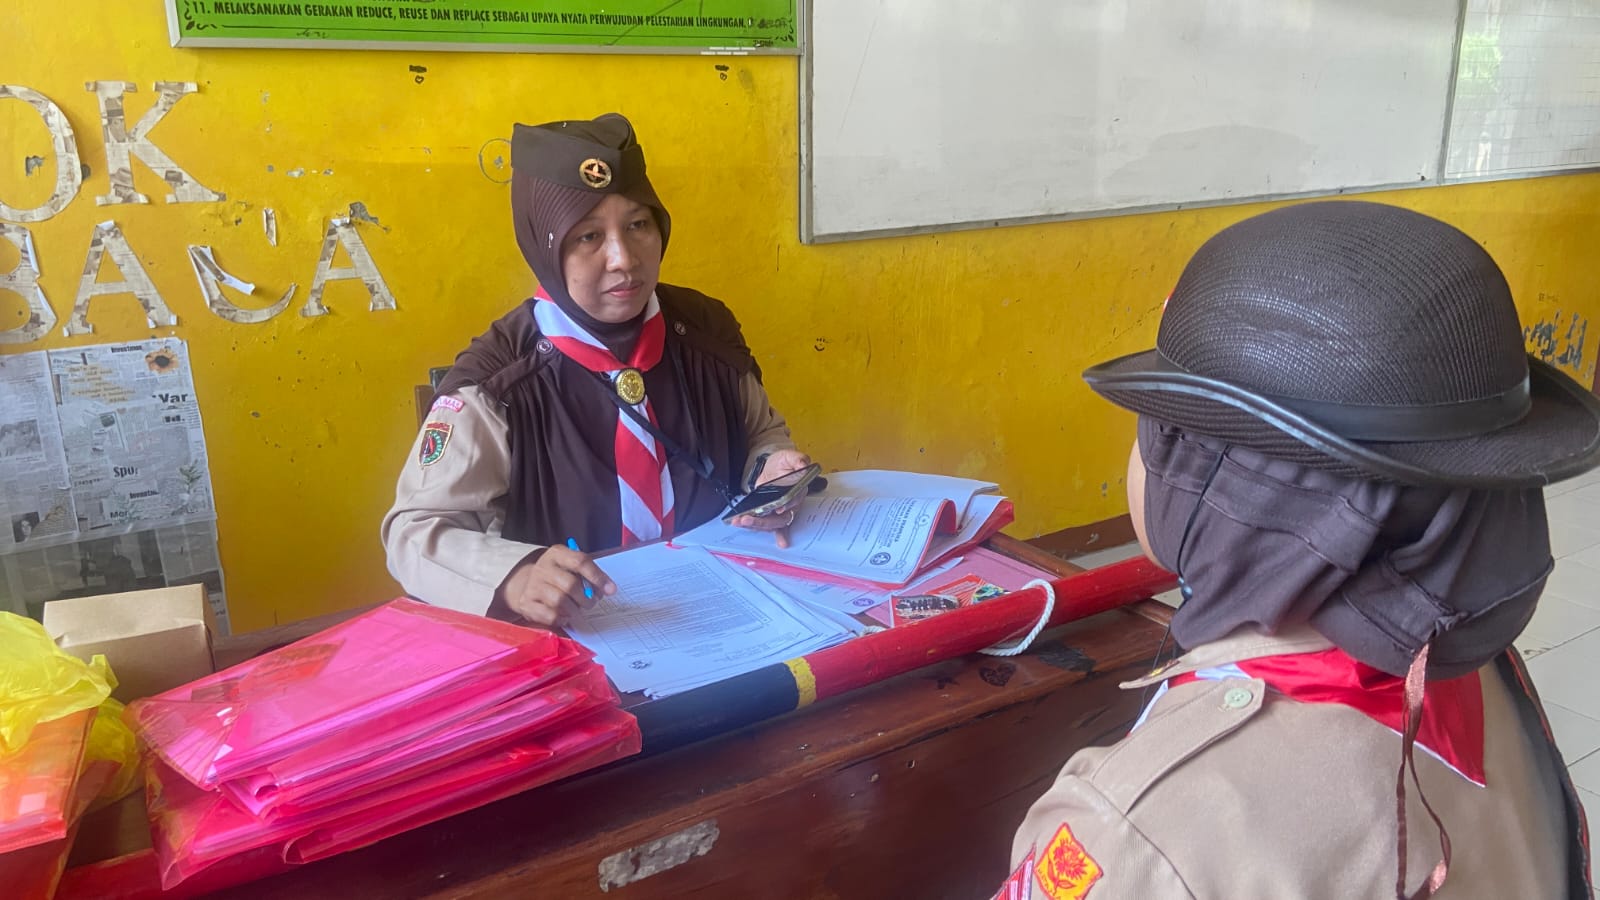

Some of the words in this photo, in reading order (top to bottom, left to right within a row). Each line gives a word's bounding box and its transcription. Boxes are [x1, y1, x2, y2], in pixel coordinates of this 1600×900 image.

[193, 1, 211, 14] 11.
[214, 2, 302, 16] MELAKSANAKAN
[304, 4, 354, 17] GERAKAN
[356, 6, 397, 20] REDUCE,
[399, 8, 428, 20] REUSE
[431, 9, 451, 21] DAN
[453, 10, 490, 22] REPLACE
[492, 11, 529, 23] SEBAGAI
[531, 12, 559, 23] UPAYA
[561, 13, 588, 25] NYATA
[589, 14, 644, 26] PERWUJUDAN
[645, 16, 694, 27] PELESTARIAN
